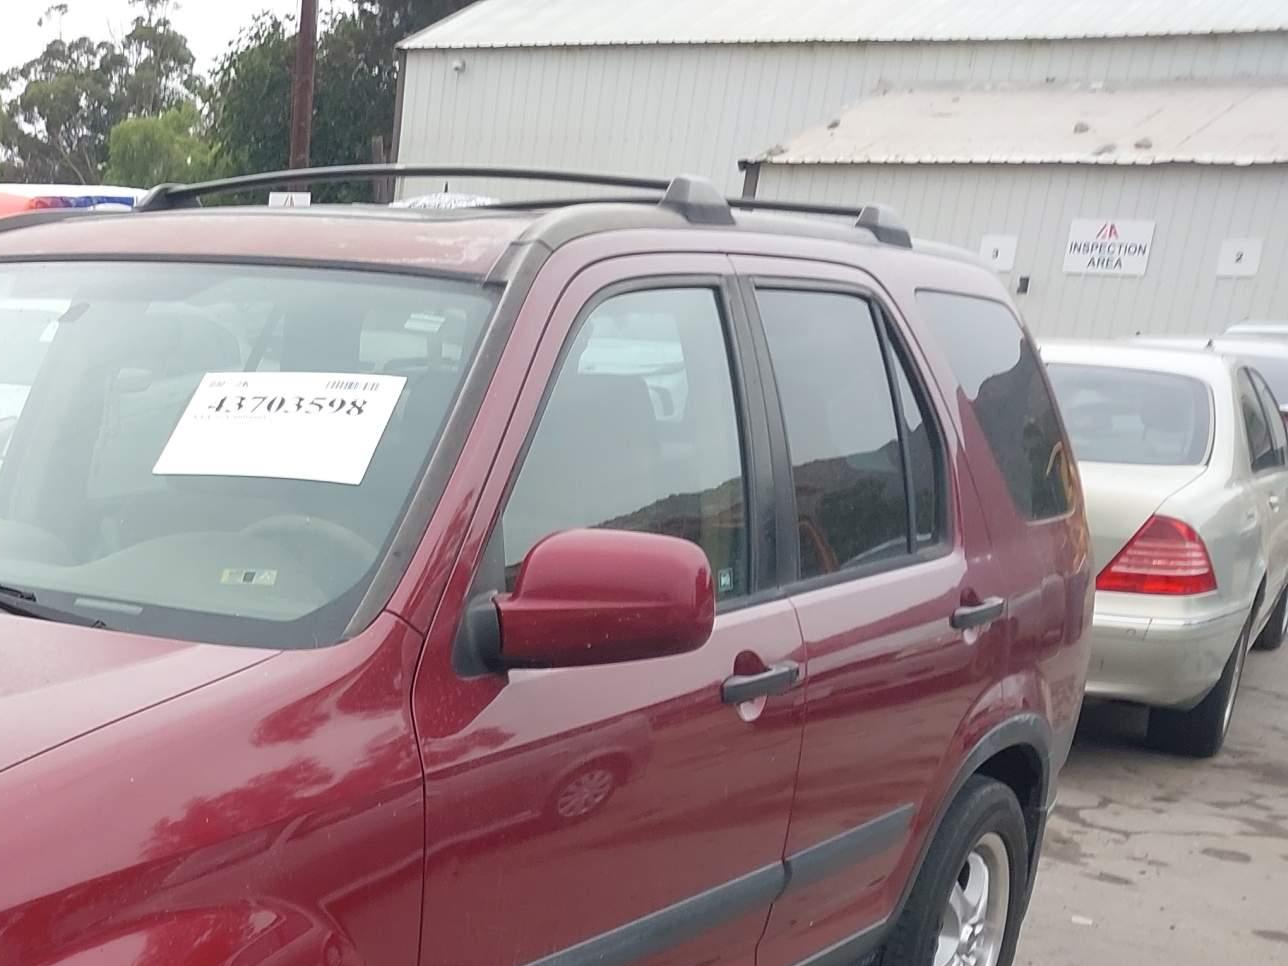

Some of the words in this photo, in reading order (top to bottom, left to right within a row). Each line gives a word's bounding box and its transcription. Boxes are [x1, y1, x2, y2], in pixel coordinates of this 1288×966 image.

[1068, 242, 1147, 256] INSPECTION
[1087, 256, 1123, 270] AREA
[208, 396, 368, 416] 43703598
